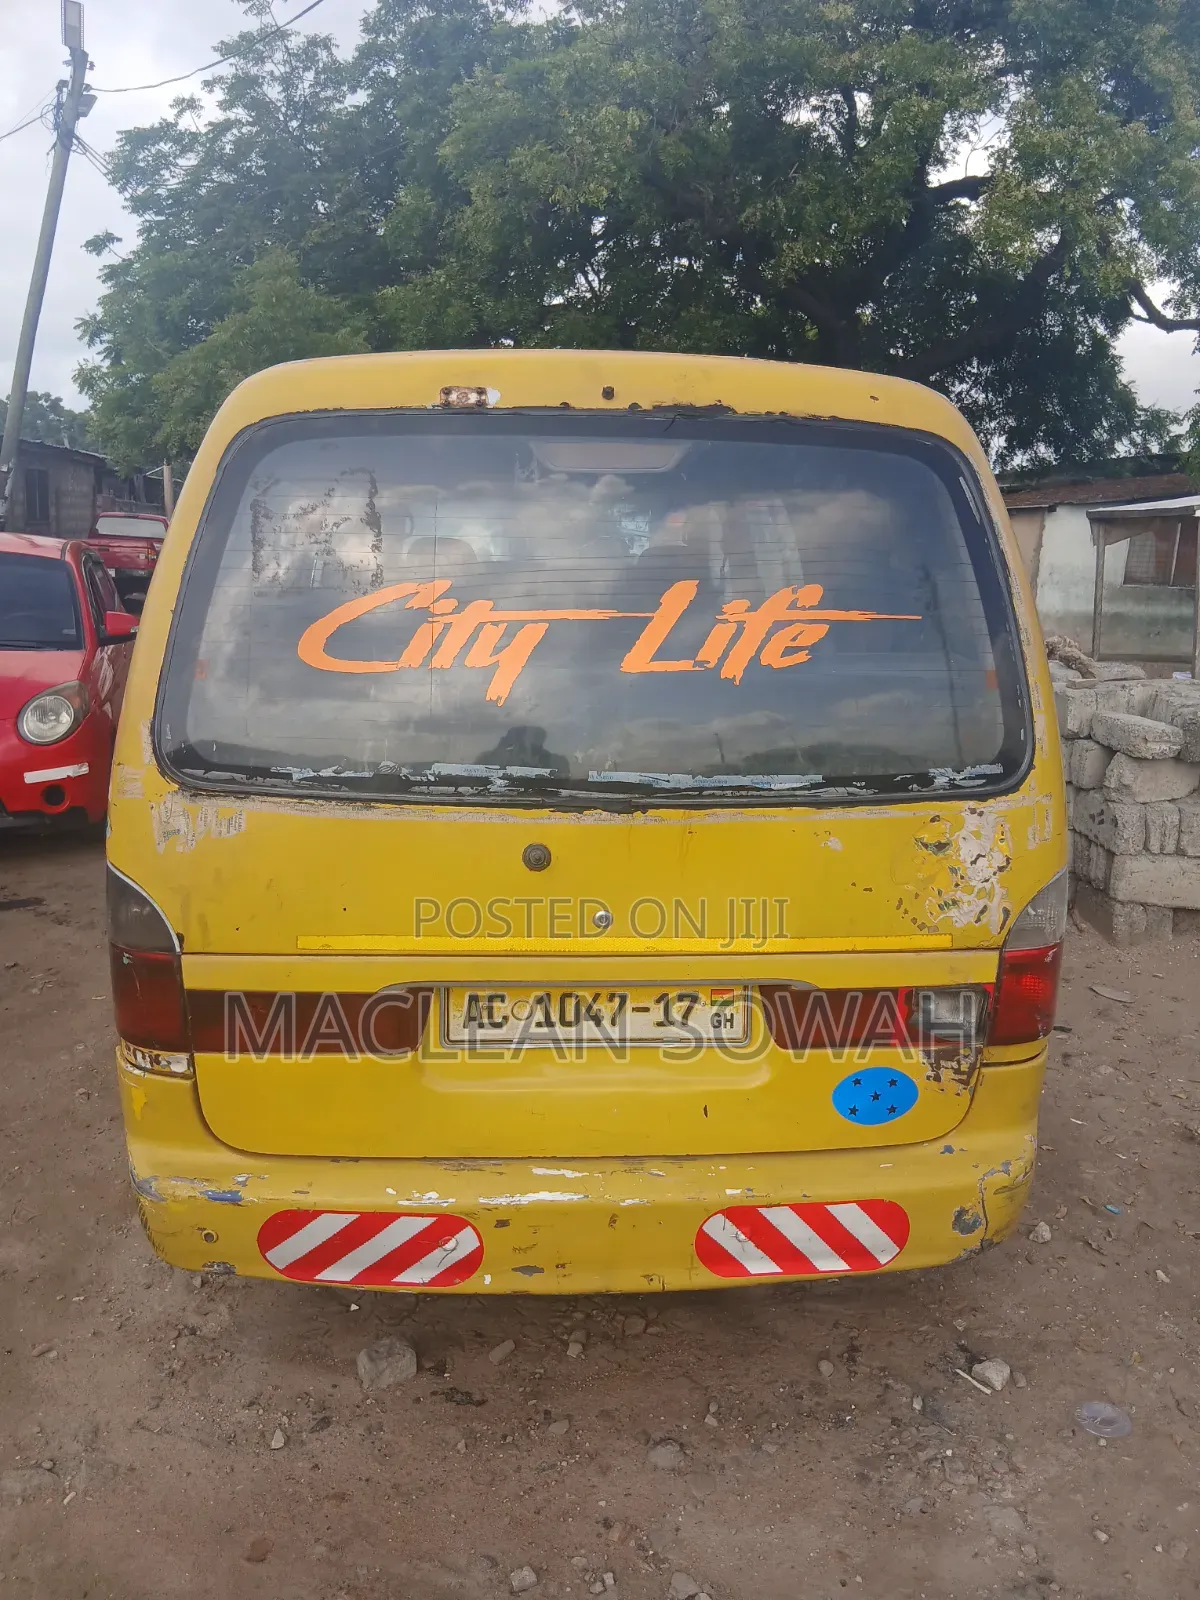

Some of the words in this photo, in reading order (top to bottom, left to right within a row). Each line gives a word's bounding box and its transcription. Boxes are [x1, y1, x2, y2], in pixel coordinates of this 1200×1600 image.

[298, 580, 622, 706] City
[620, 580, 922, 685] Life
[461, 992, 510, 1030] AC
[534, 991, 701, 1030] 1047-17
[710, 1012, 735, 1030] GH
